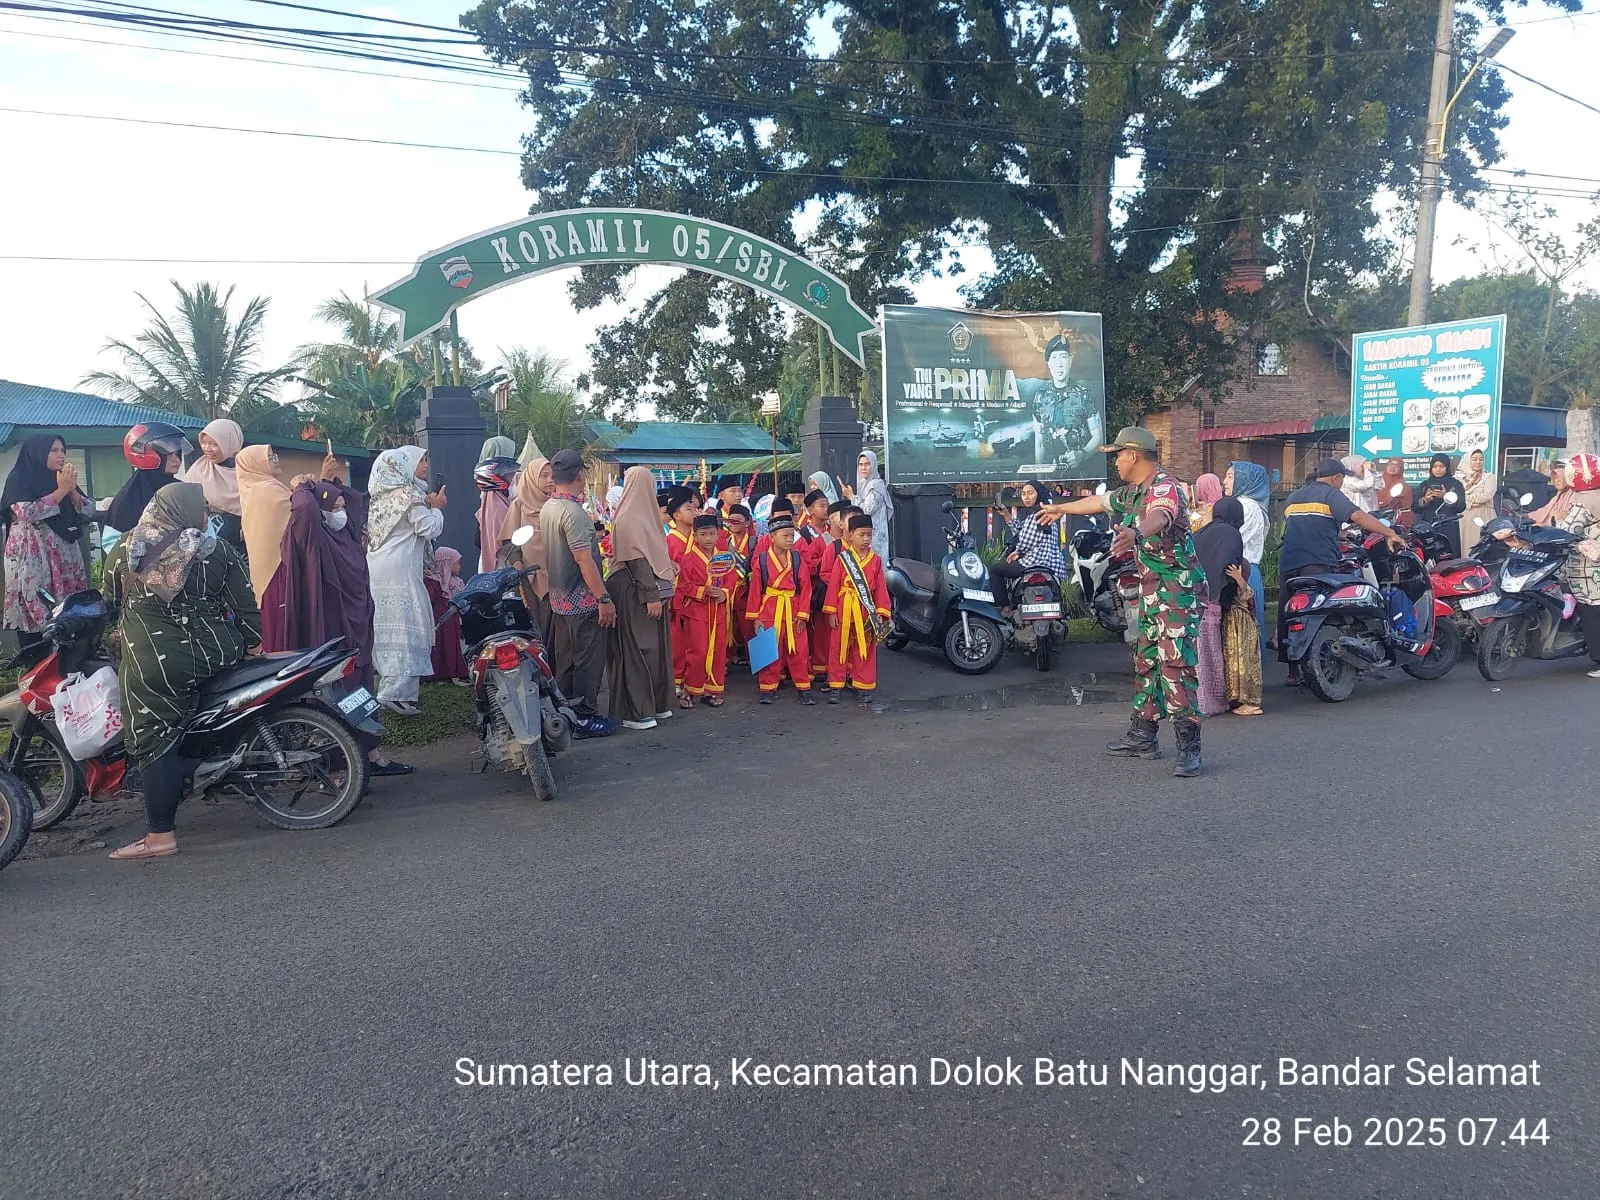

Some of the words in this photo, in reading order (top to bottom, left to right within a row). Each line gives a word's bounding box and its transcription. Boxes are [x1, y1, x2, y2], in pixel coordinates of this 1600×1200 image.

[491, 218, 650, 274] KORAMIL
[673, 224, 790, 293] 05/SBL
[1389, 359, 1418, 369] KORAMIL
[914, 367, 933, 384] TNI
[934, 367, 1021, 400] PRIMA
[903, 383, 933, 399] YANG
